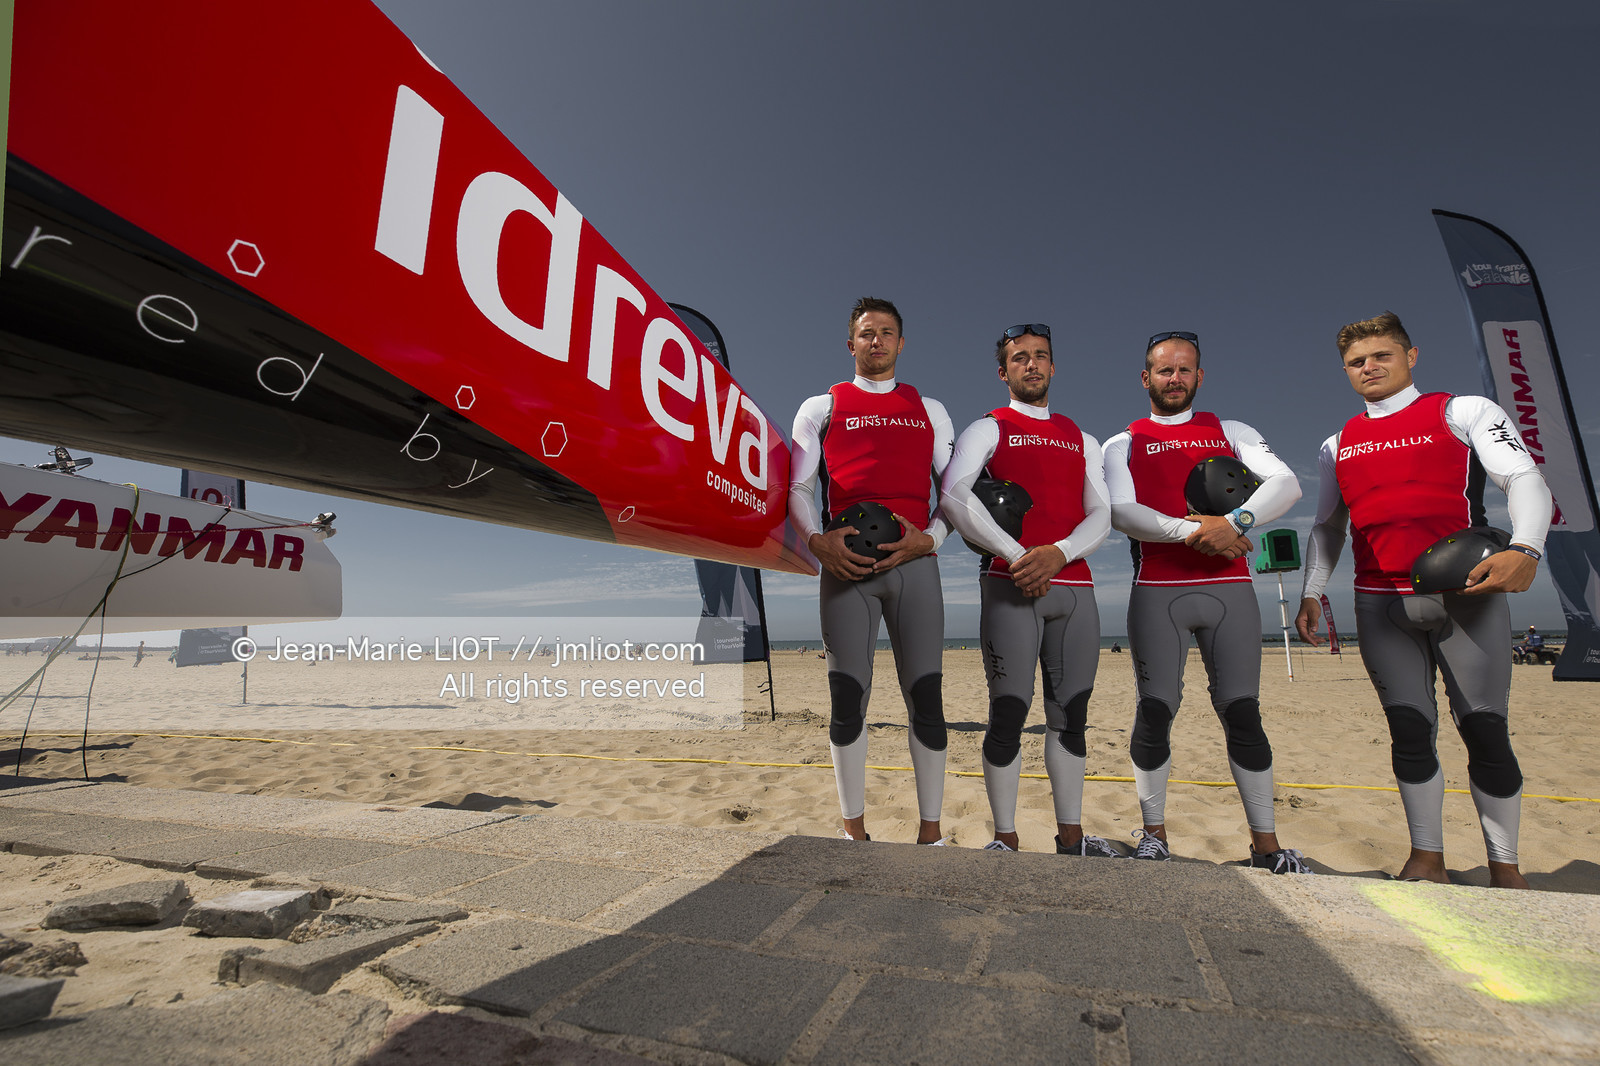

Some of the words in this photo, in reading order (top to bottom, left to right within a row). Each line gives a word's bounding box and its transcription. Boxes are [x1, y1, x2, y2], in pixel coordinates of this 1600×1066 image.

[374, 84, 768, 491] Idreva
[860, 417, 926, 430] INSTALLUX
[400, 413, 494, 489] by
[1023, 437, 1080, 452] INSTALLUX
[1161, 440, 1227, 452] INSTALLUX
[1352, 435, 1434, 457] INSTALLUX
[706, 470, 767, 515] composites
[0, 491, 305, 573] YANMAR
